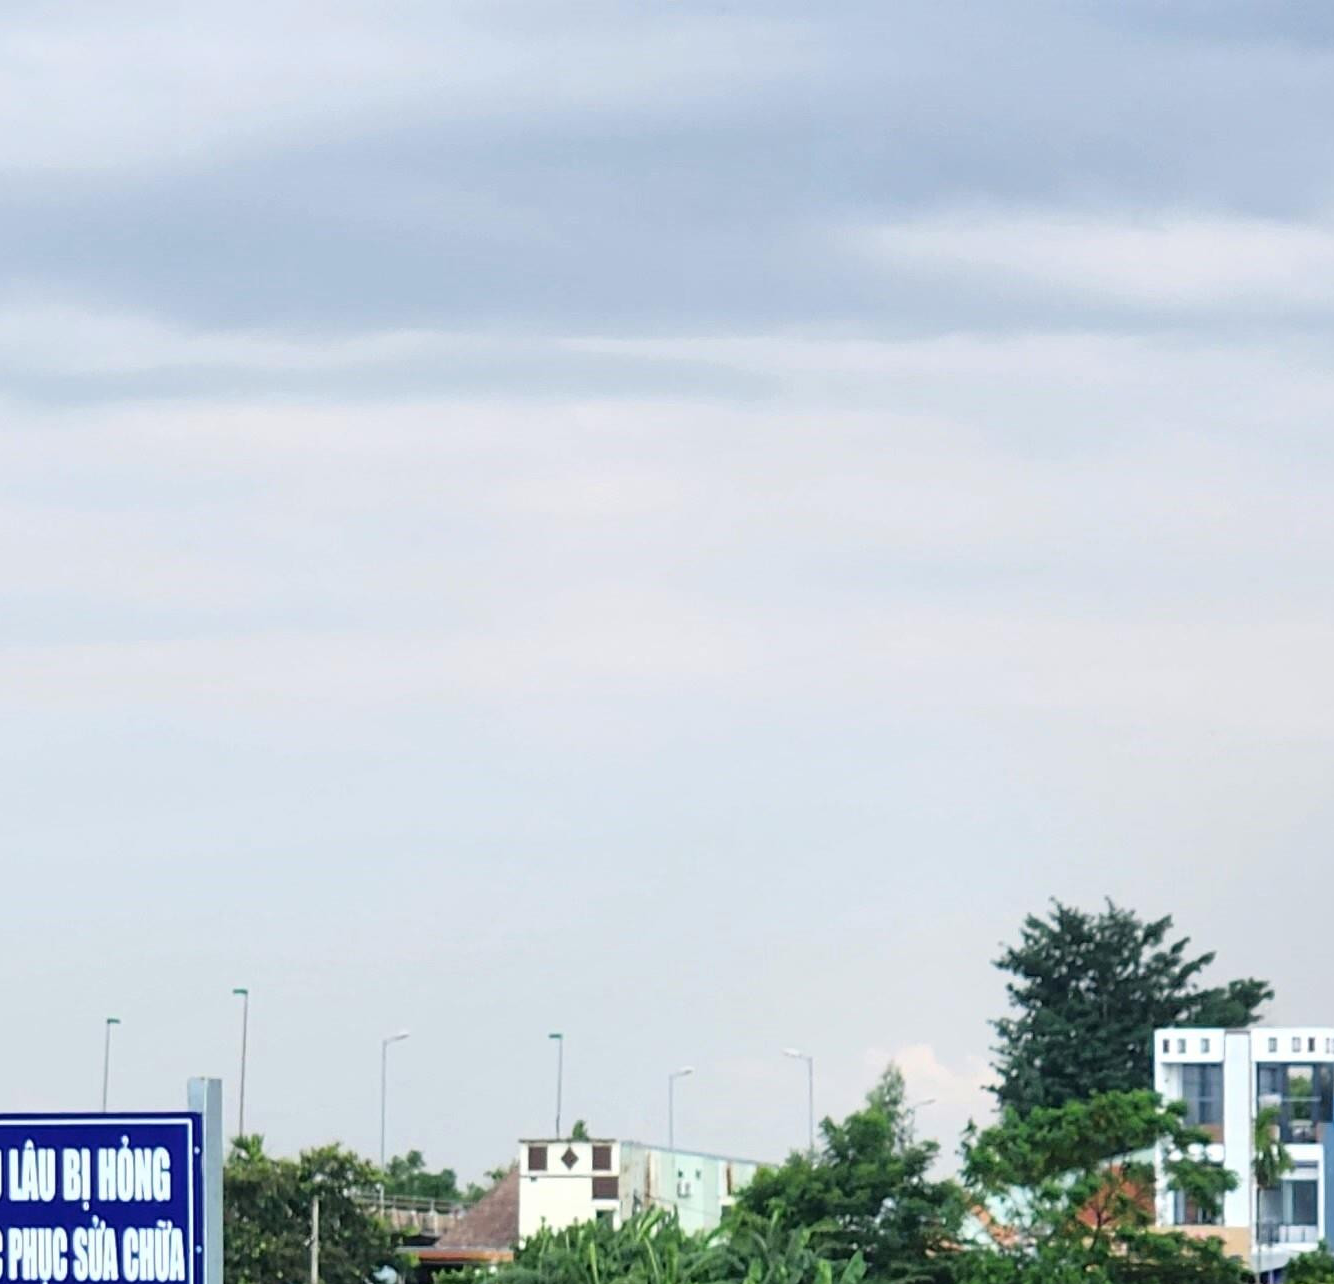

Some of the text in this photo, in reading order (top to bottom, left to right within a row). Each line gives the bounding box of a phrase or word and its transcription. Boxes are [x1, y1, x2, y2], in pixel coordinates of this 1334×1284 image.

[8, 1139, 56, 1202] LÂU
[62, 1147, 91, 1211] BỊ
[97, 1135, 171, 1202] HỎNG
[72, 1215, 119, 1281] SỬA
[123, 1219, 186, 1281] CHỮA
